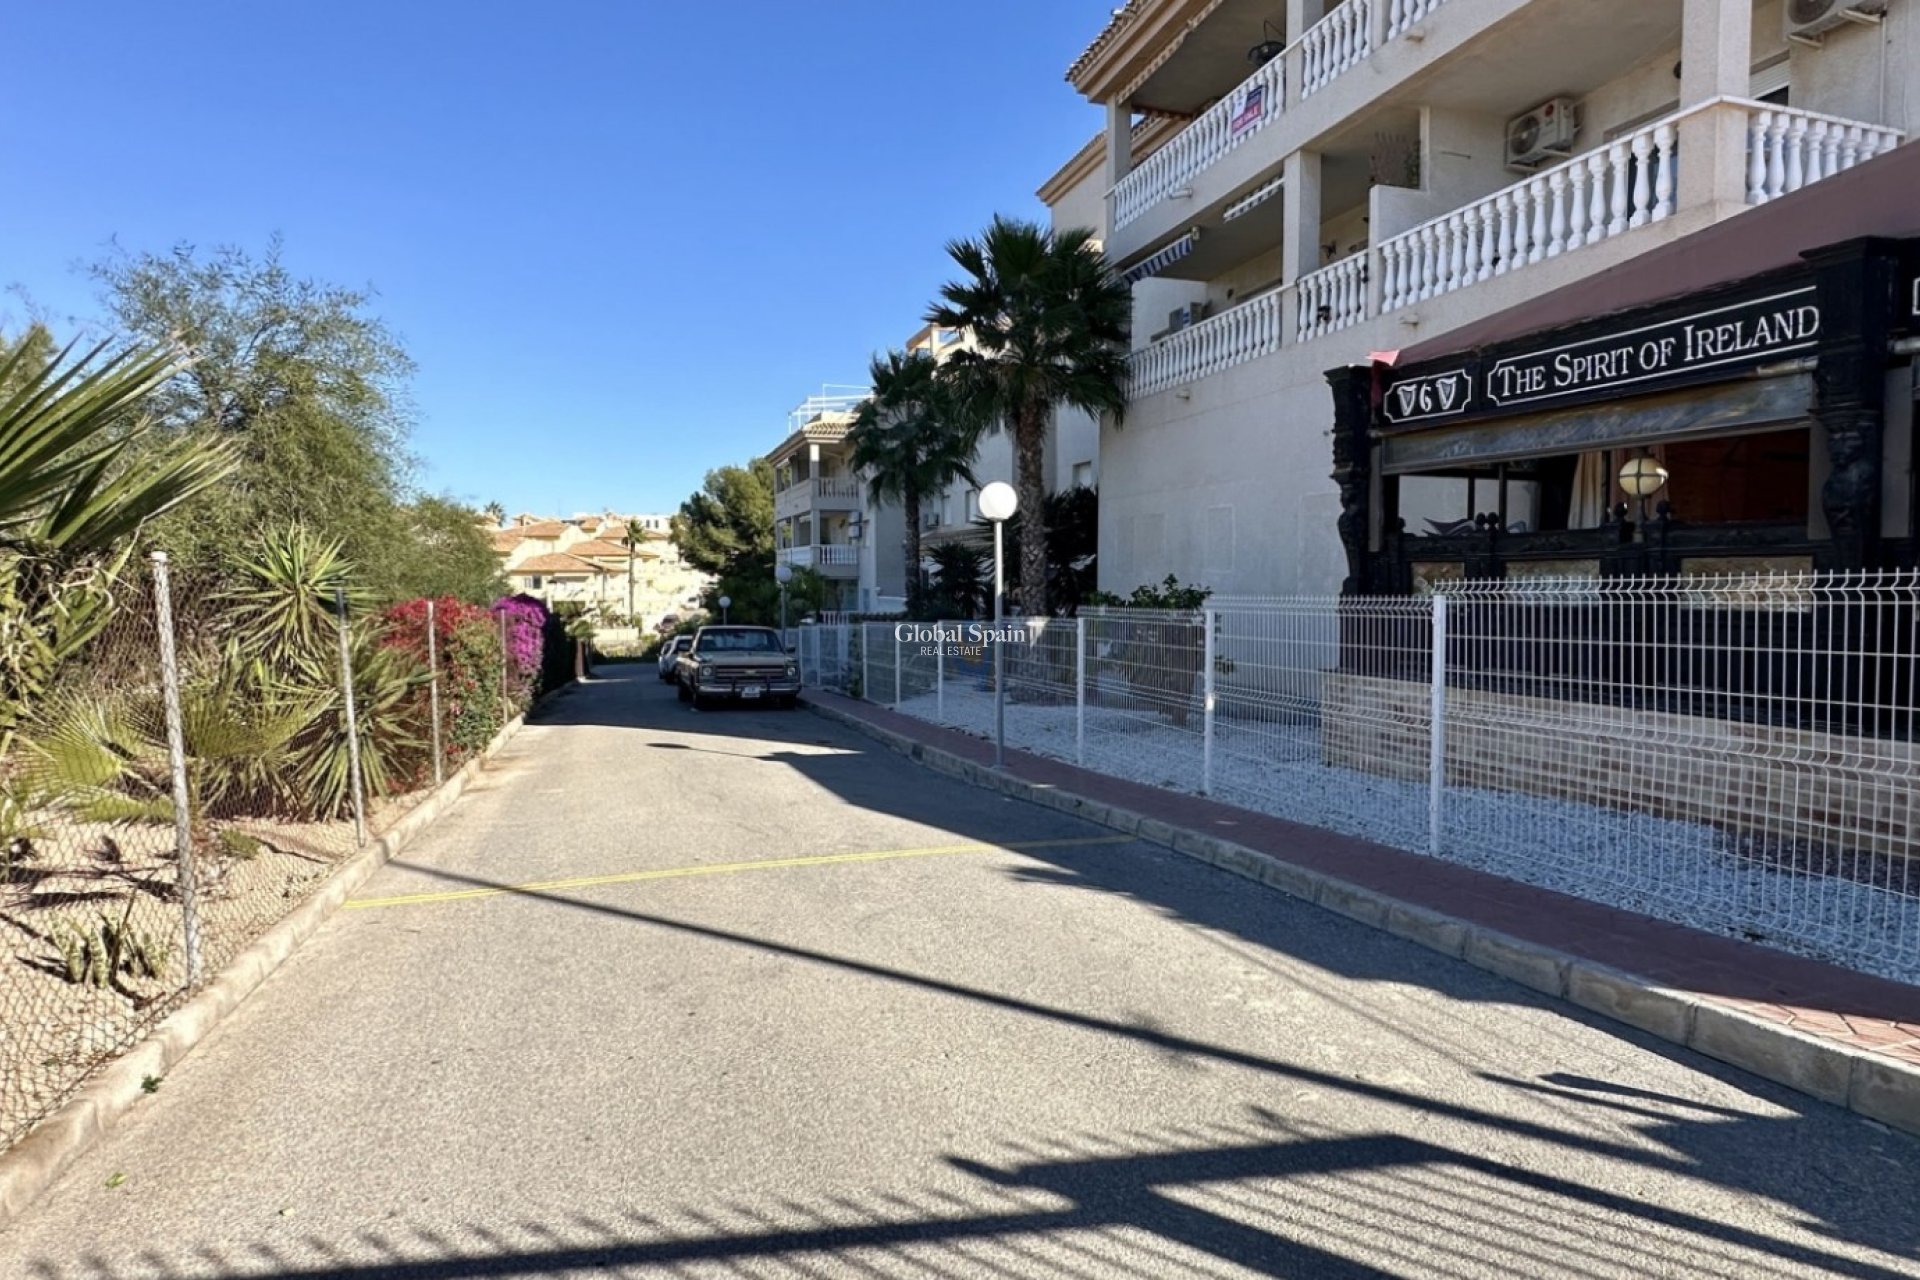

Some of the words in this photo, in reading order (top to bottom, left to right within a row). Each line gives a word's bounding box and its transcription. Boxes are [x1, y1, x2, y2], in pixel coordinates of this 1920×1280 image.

[1498, 365, 1546, 397] THE
[1554, 346, 1634, 387] SPIRIT
[1639, 337, 1676, 370] OF
[1684, 305, 1820, 361] IRELAND
